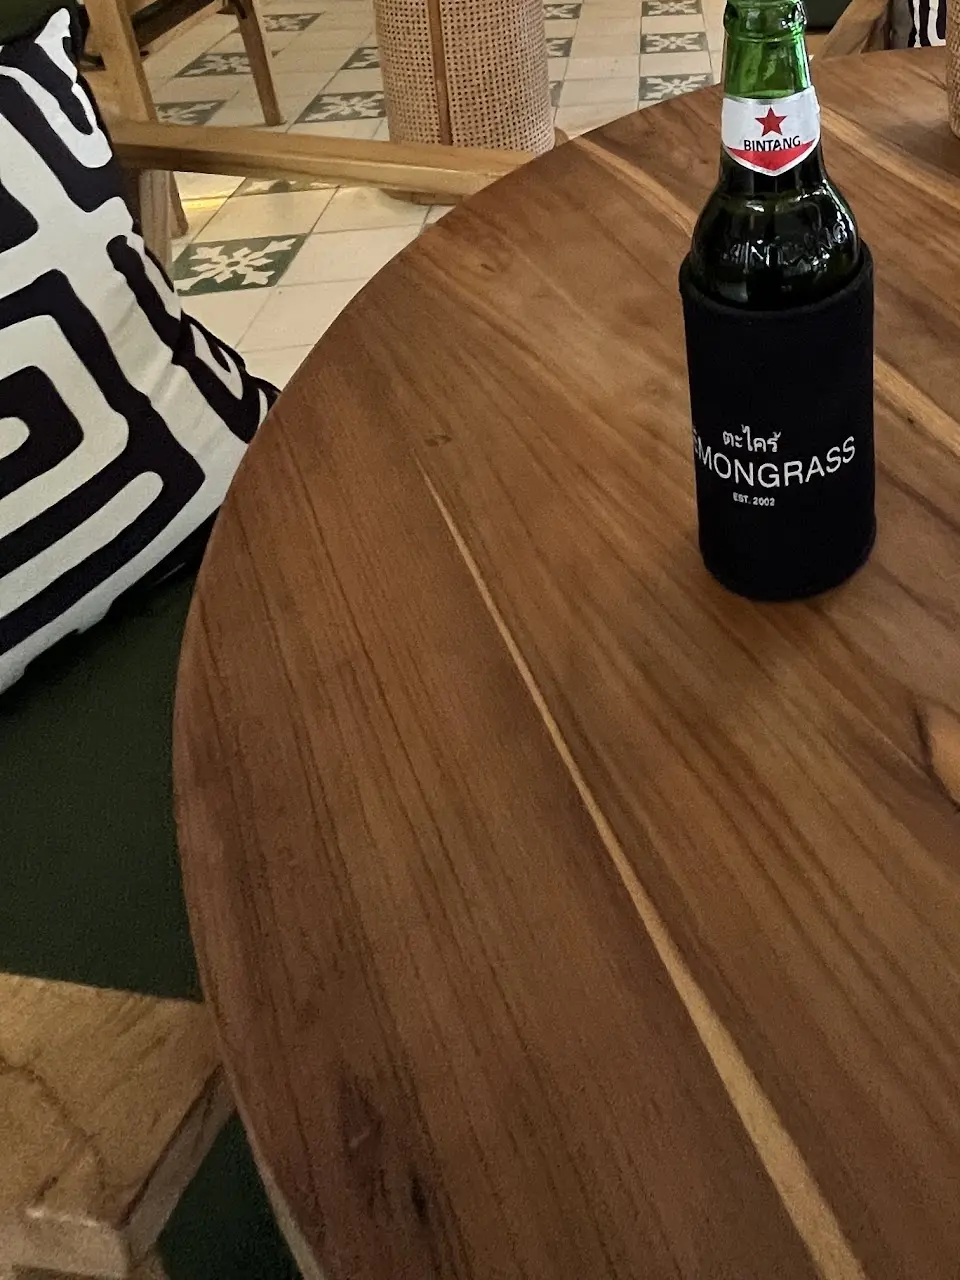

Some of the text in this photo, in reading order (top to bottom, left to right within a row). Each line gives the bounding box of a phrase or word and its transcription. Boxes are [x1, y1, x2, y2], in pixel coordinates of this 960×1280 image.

[743, 135, 801, 152] BINTANG
[722, 424, 782, 453] ตะไคร้
[732, 492, 776, 506] EST. 2002
